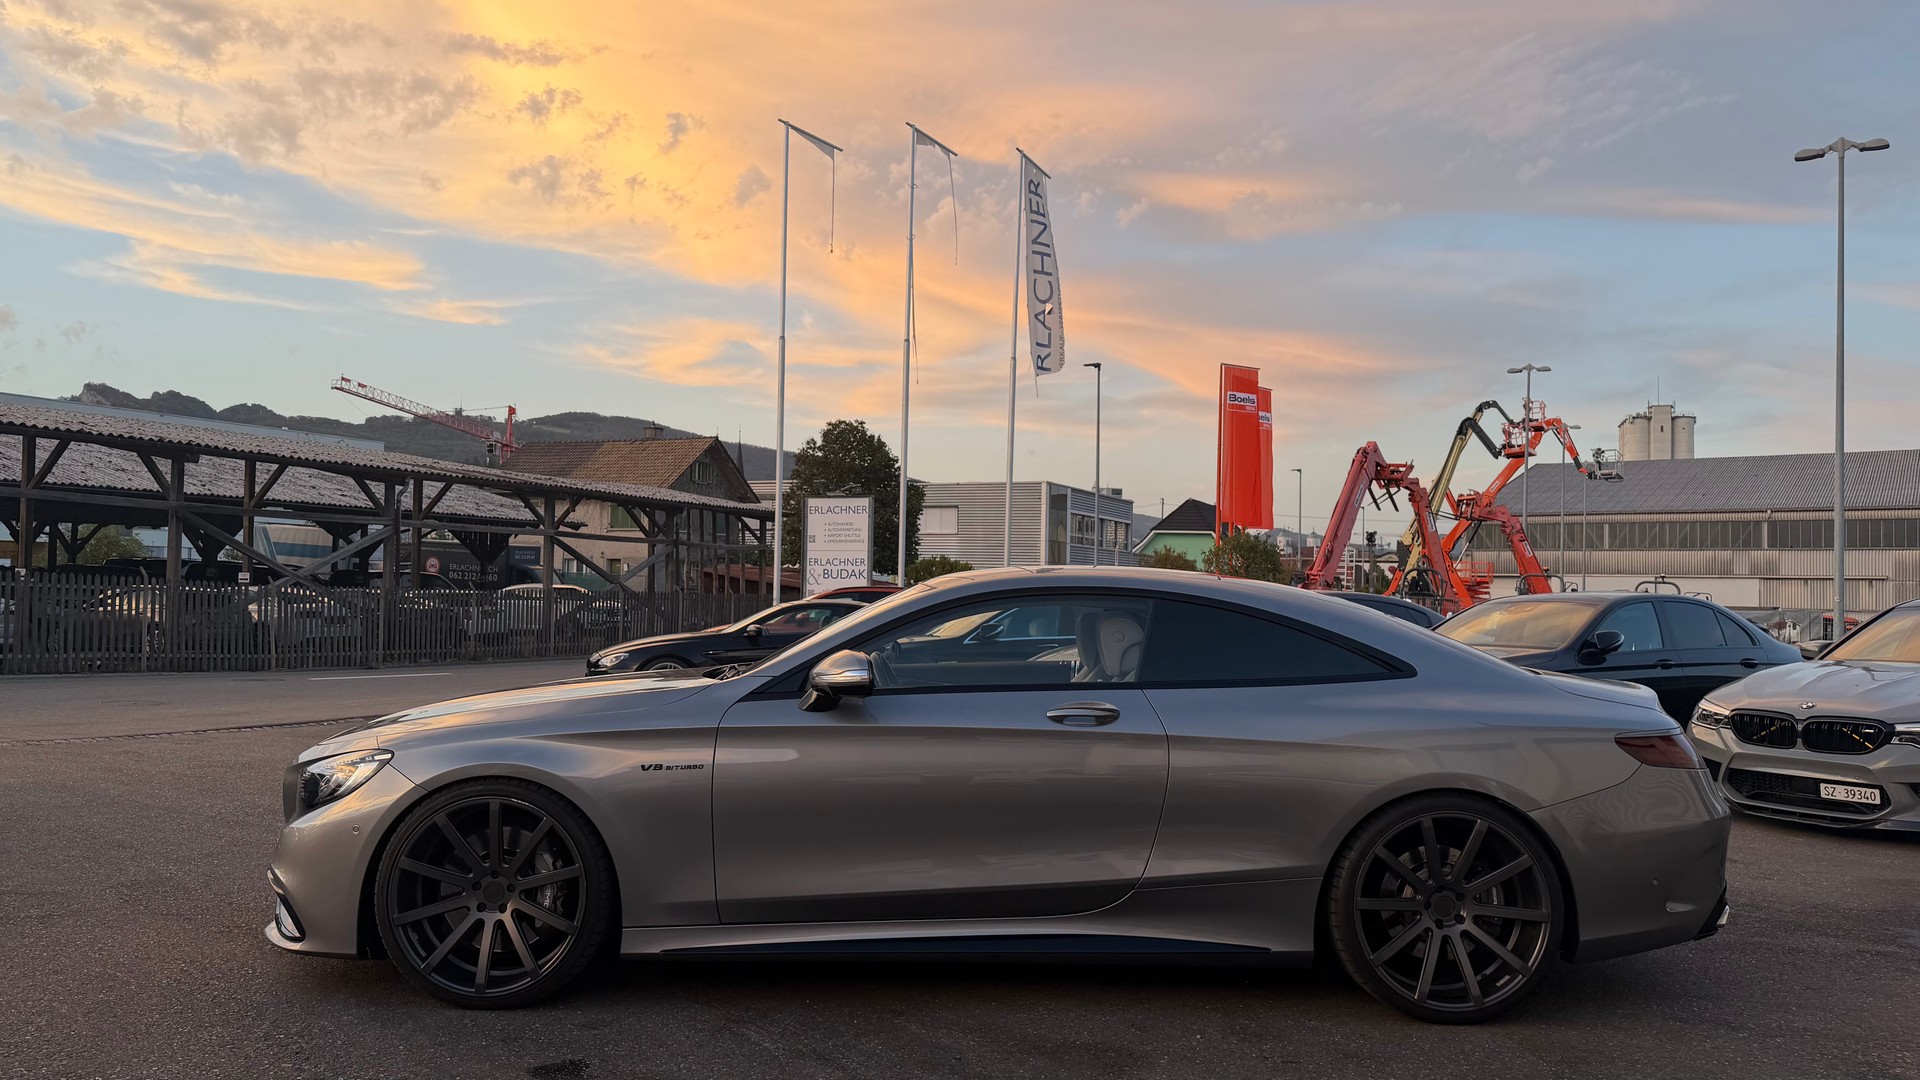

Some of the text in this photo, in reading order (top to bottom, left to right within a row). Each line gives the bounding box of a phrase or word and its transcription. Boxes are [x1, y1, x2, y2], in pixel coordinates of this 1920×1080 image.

[1028, 177, 1054, 376] RLACHNER
[1229, 394, 1255, 404] Boels
[1258, 413, 1270, 422] els
[809, 505, 868, 515] ERLACHNER
[808, 557, 866, 567] ERLACHNER
[807, 568, 866, 585] & BUDAK
[1824, 786, 1876, 802] SZ 39340
